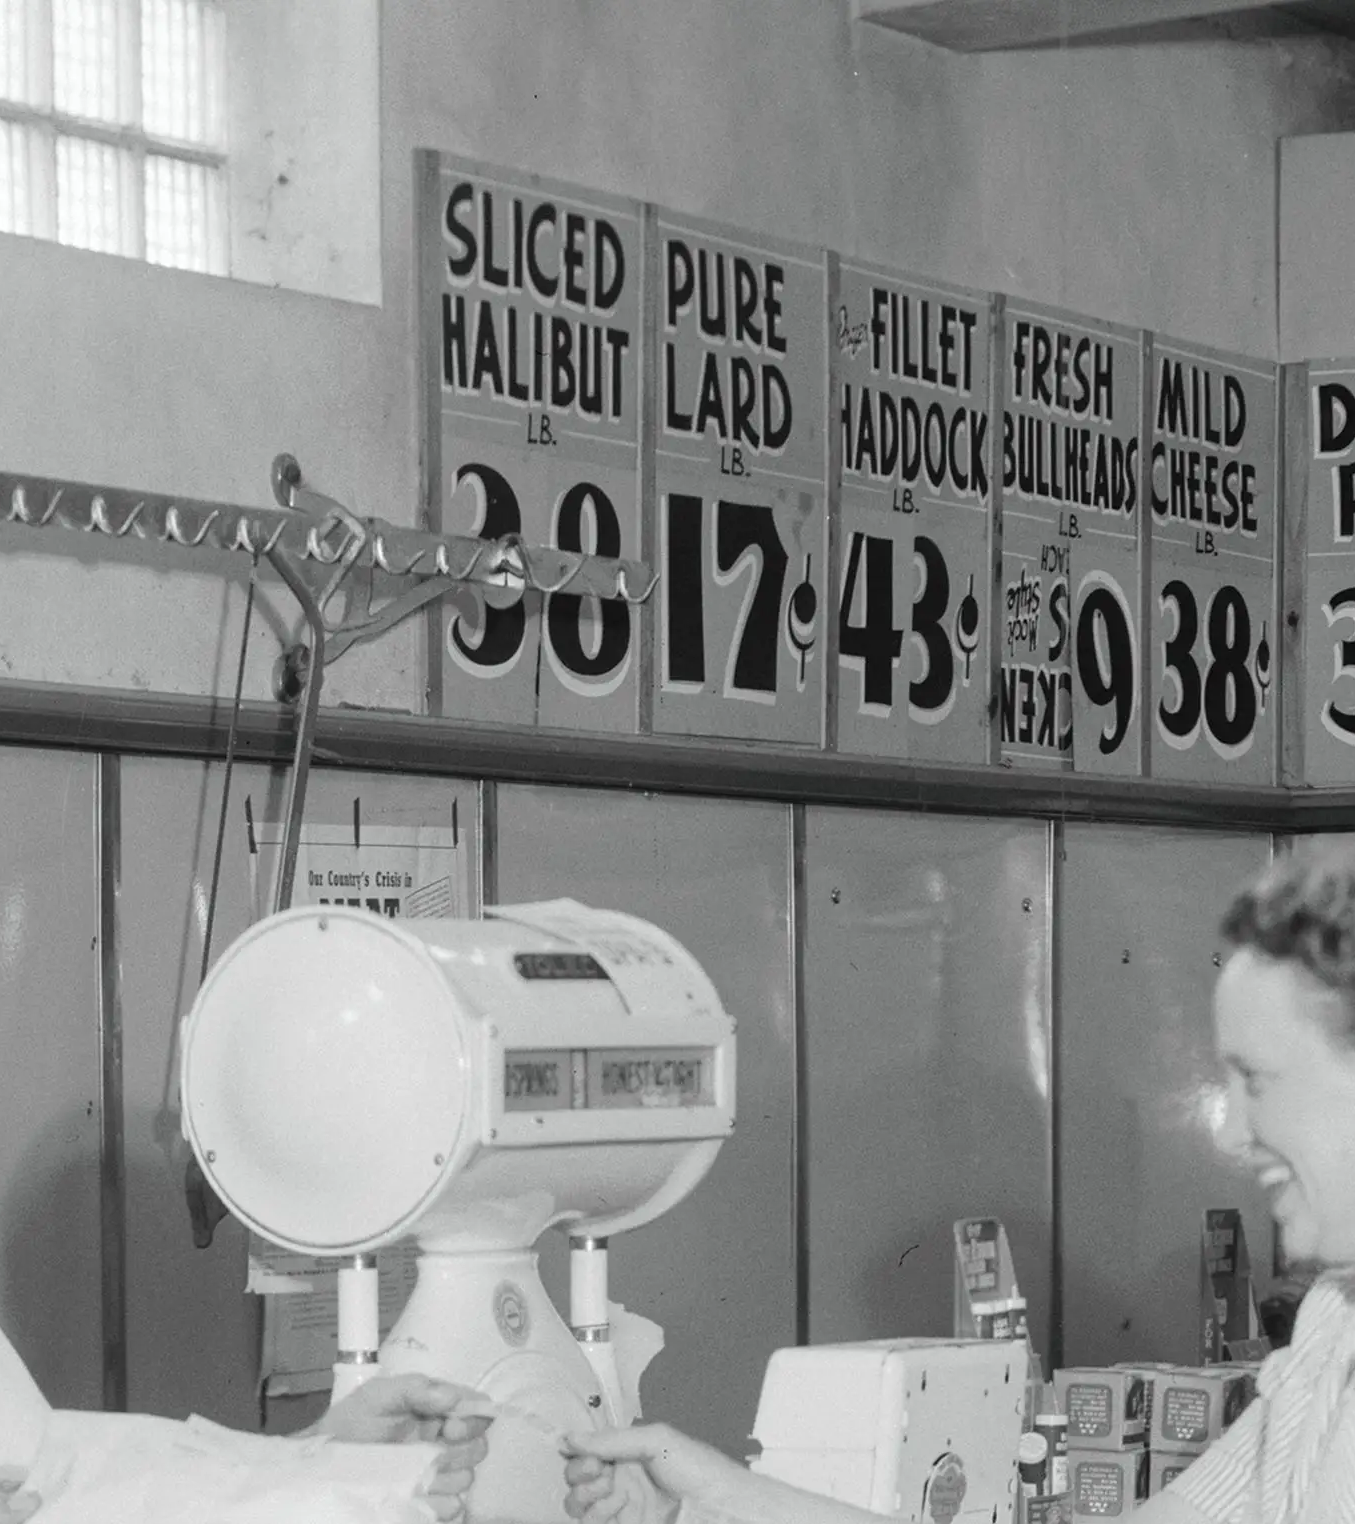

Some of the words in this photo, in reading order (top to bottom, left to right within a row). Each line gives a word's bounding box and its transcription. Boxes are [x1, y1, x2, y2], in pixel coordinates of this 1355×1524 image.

[445, 182, 625, 312] SLICED
[668, 240, 787, 354] PURE
[871, 288, 977, 391] FILLET
[443, 294, 630, 418] HALIBUT
[666, 344, 793, 451] LARD
[1013, 323, 1113, 421] FRESH
[527, 413, 557, 446] LB.
[1160, 360, 1245, 448] MILD
[721, 447, 751, 477] LB.
[892, 488, 919, 514] LB.
[1004, 412, 1137, 514] BULLHEADS
[1152, 440, 1258, 531] CHEESE
[1041, 545, 1069, 575] ACH
[1059, 512, 1082, 538] LB.
[1195, 531, 1218, 556] LB.
[1076, 588, 1137, 755] 9
[308, 870, 324, 887] Our
[328, 870, 370, 891] Country's
[376, 871, 402, 888] Crisis
[404, 872, 413, 888] in
